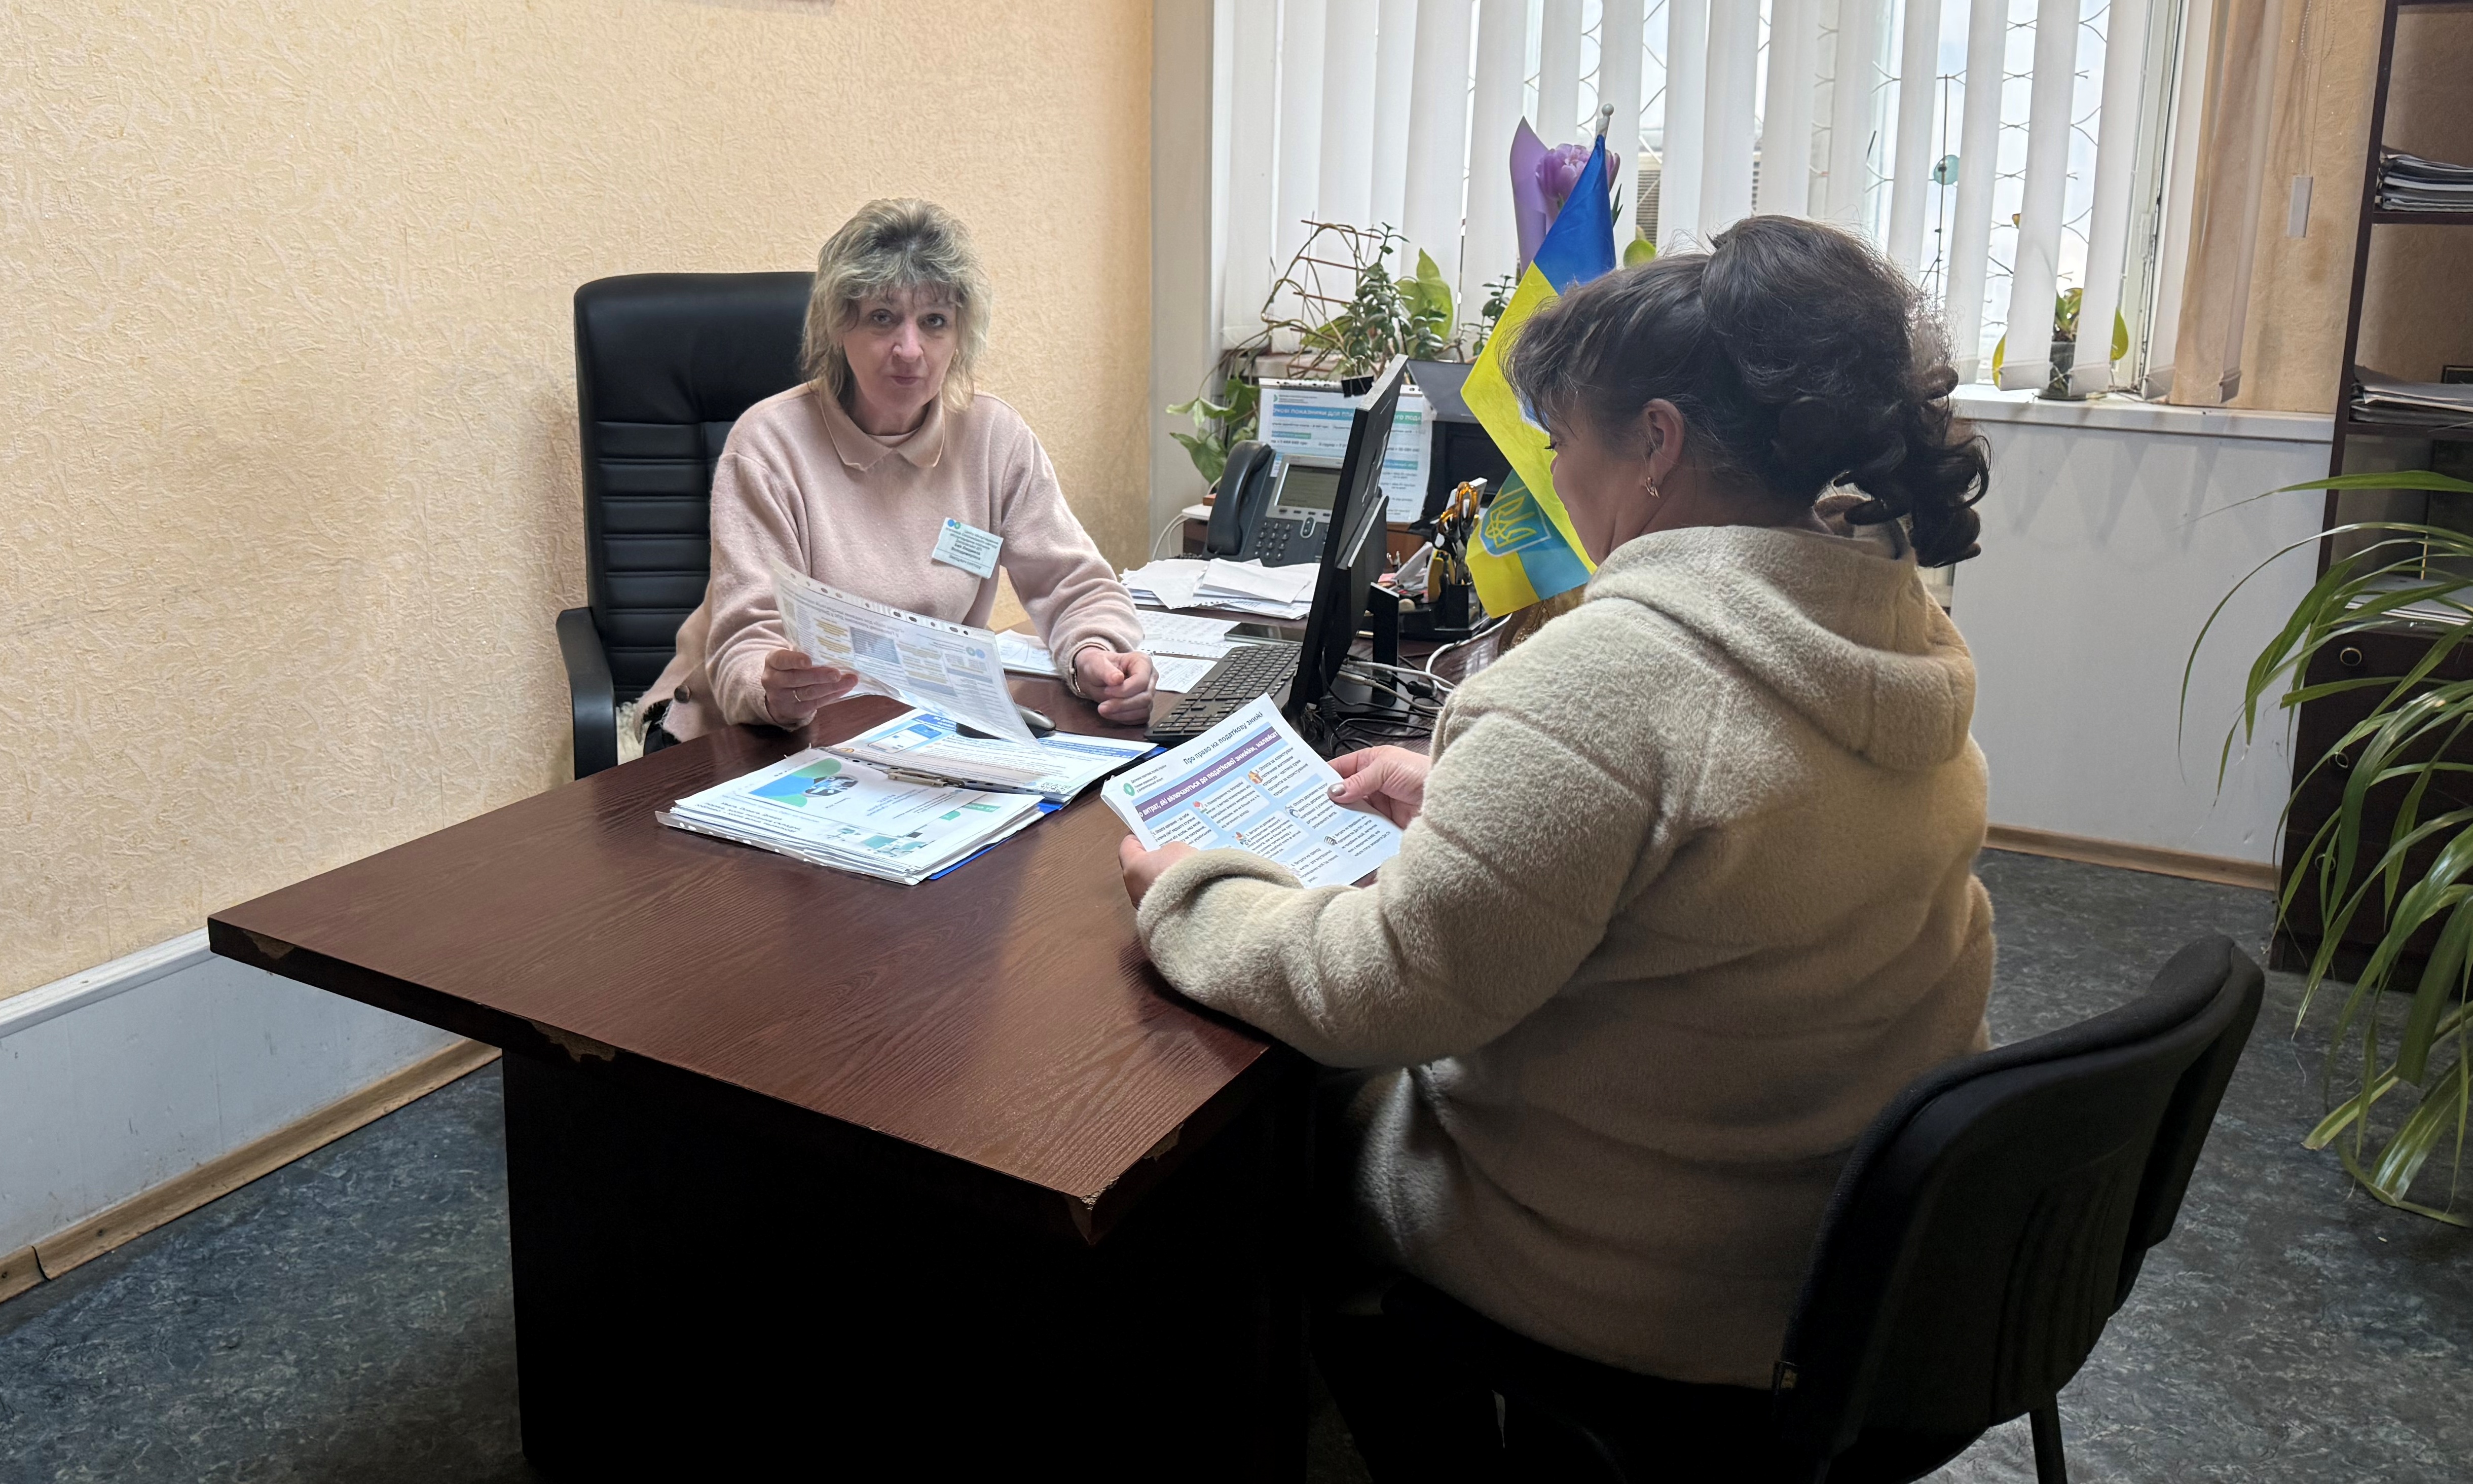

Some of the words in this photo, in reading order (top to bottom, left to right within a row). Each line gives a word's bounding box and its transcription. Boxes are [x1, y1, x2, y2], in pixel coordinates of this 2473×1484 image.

[1183, 756, 1195, 765] Про
[1194, 747, 1211, 758] право
[1219, 723, 1247, 744] податкову
[1142, 803, 1161, 815] витрат,
[1160, 797, 1168, 806] які
[1167, 781, 1201, 802] включаються
[1207, 758, 1236, 778] податкової
[1235, 747, 1258, 761] знижки,
